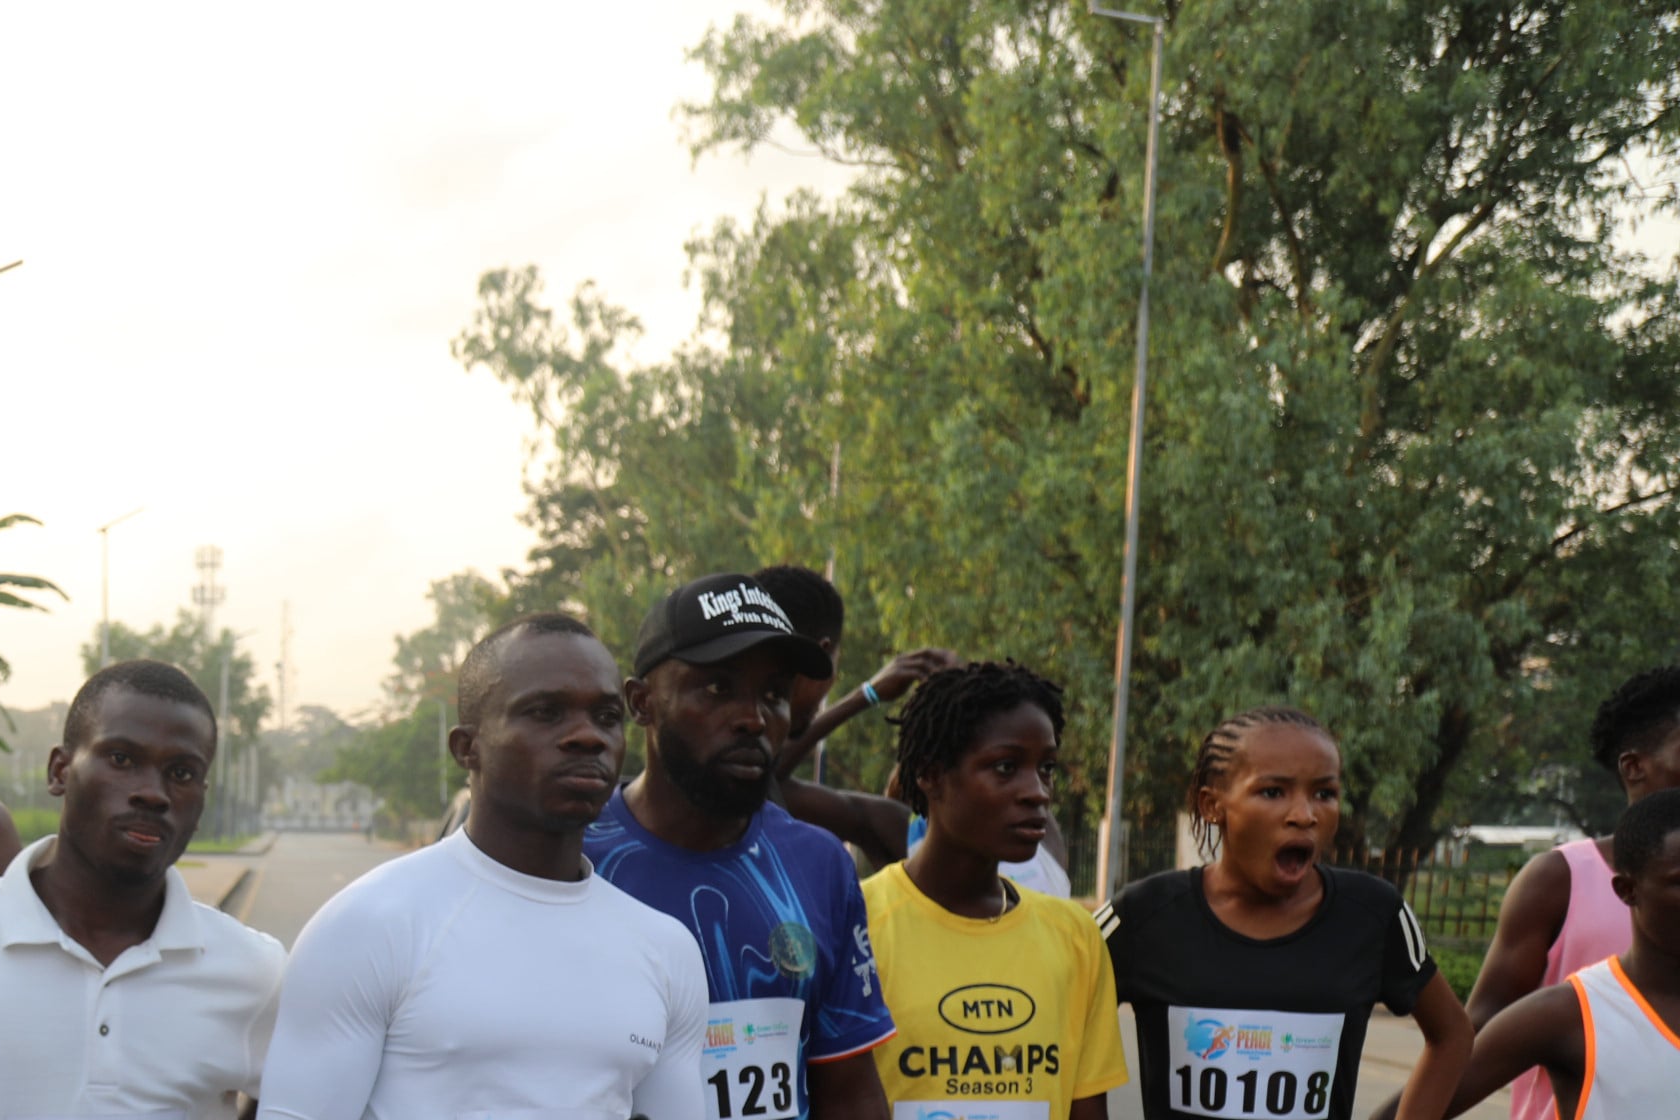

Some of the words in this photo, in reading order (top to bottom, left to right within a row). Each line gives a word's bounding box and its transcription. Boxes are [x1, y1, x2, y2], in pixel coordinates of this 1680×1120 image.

[698, 590, 742, 620] Kings
[962, 999, 1014, 1018] MTN
[898, 1044, 1059, 1078] CHAMPS
[707, 1062, 792, 1119] 123
[946, 1078, 1019, 1095] Season
[1025, 1077, 1033, 1094] 3
[1176, 1065, 1330, 1116] 10108
